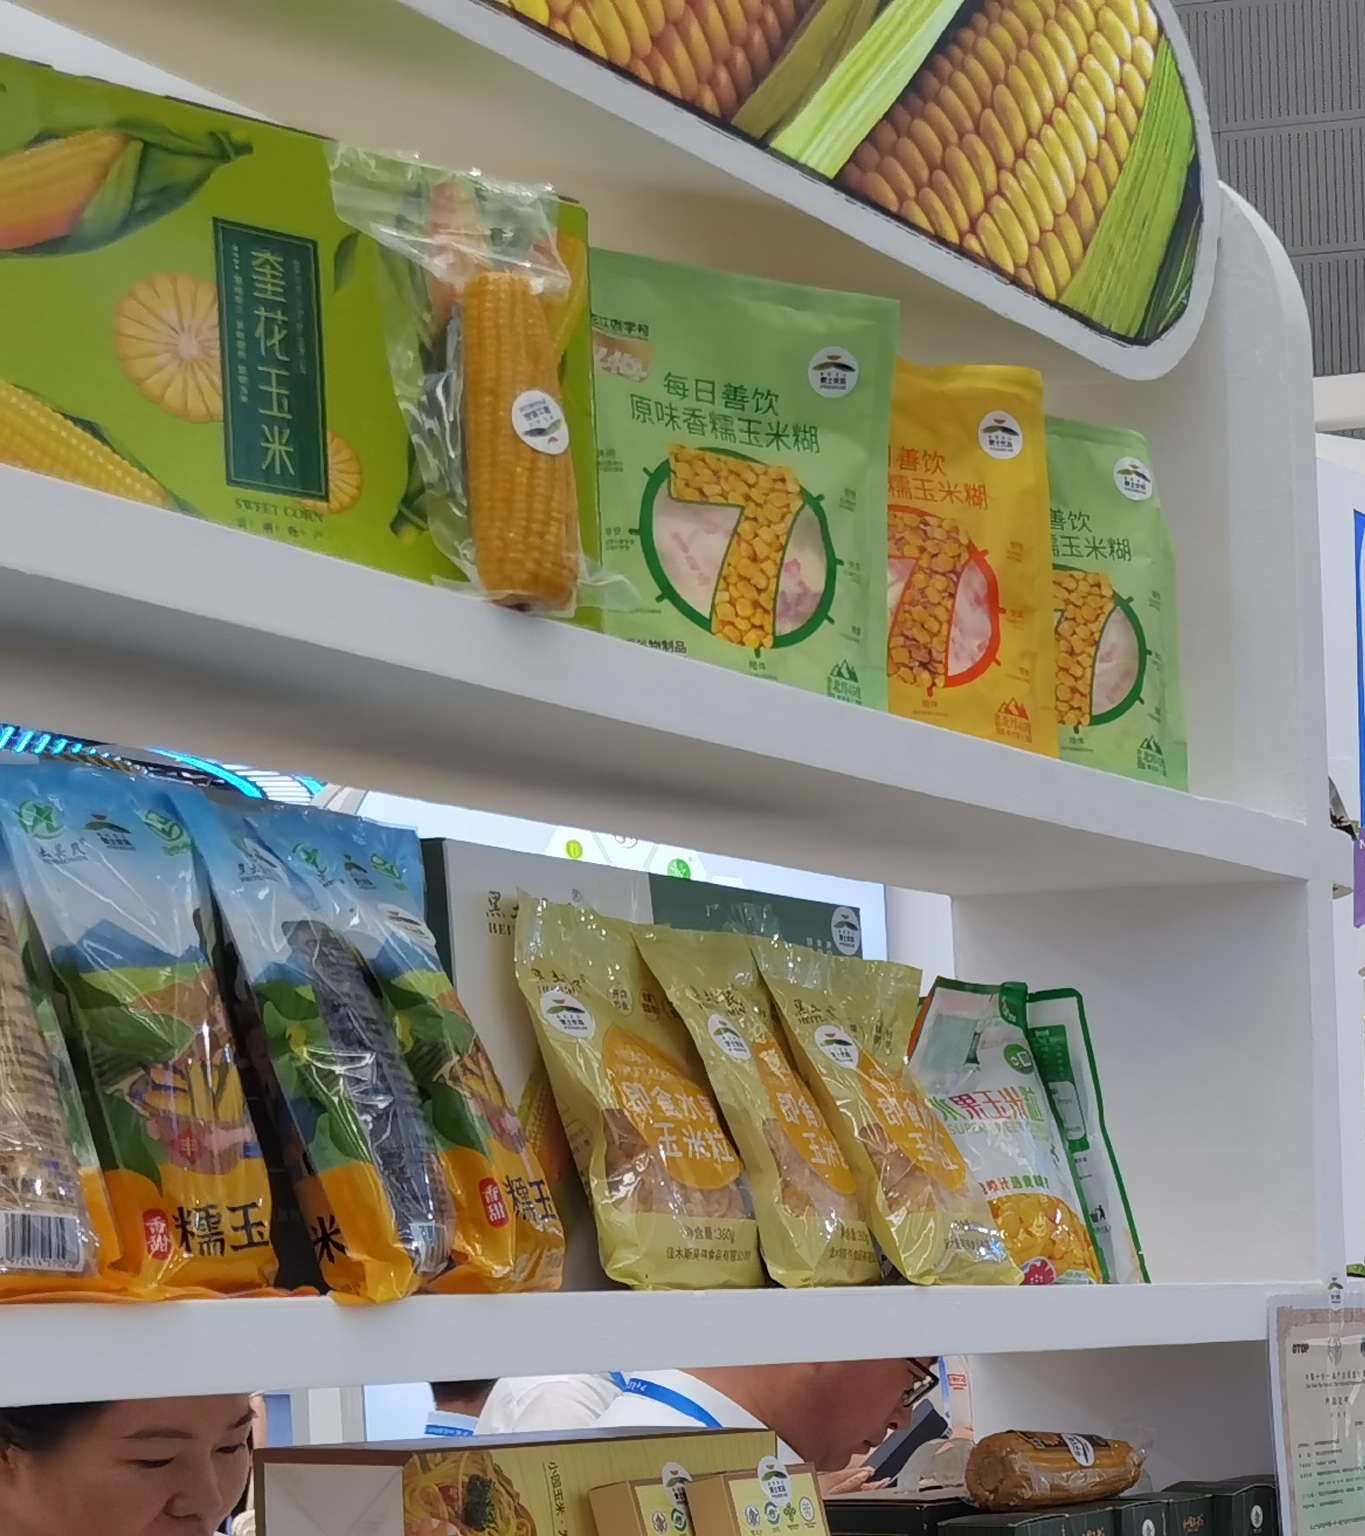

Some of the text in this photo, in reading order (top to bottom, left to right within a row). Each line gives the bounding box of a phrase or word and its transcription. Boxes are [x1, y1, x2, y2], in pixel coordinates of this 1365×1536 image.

[663, 372, 780, 417] 每日善饮
[630, 393, 820, 454] 原味香糯玉米糊
[888, 444, 946, 477] 善饮
[654, 1122, 735, 1163] 玉米粒
[172, 1201, 271, 1258] 糯玉
[312, 1212, 348, 1264] 米
